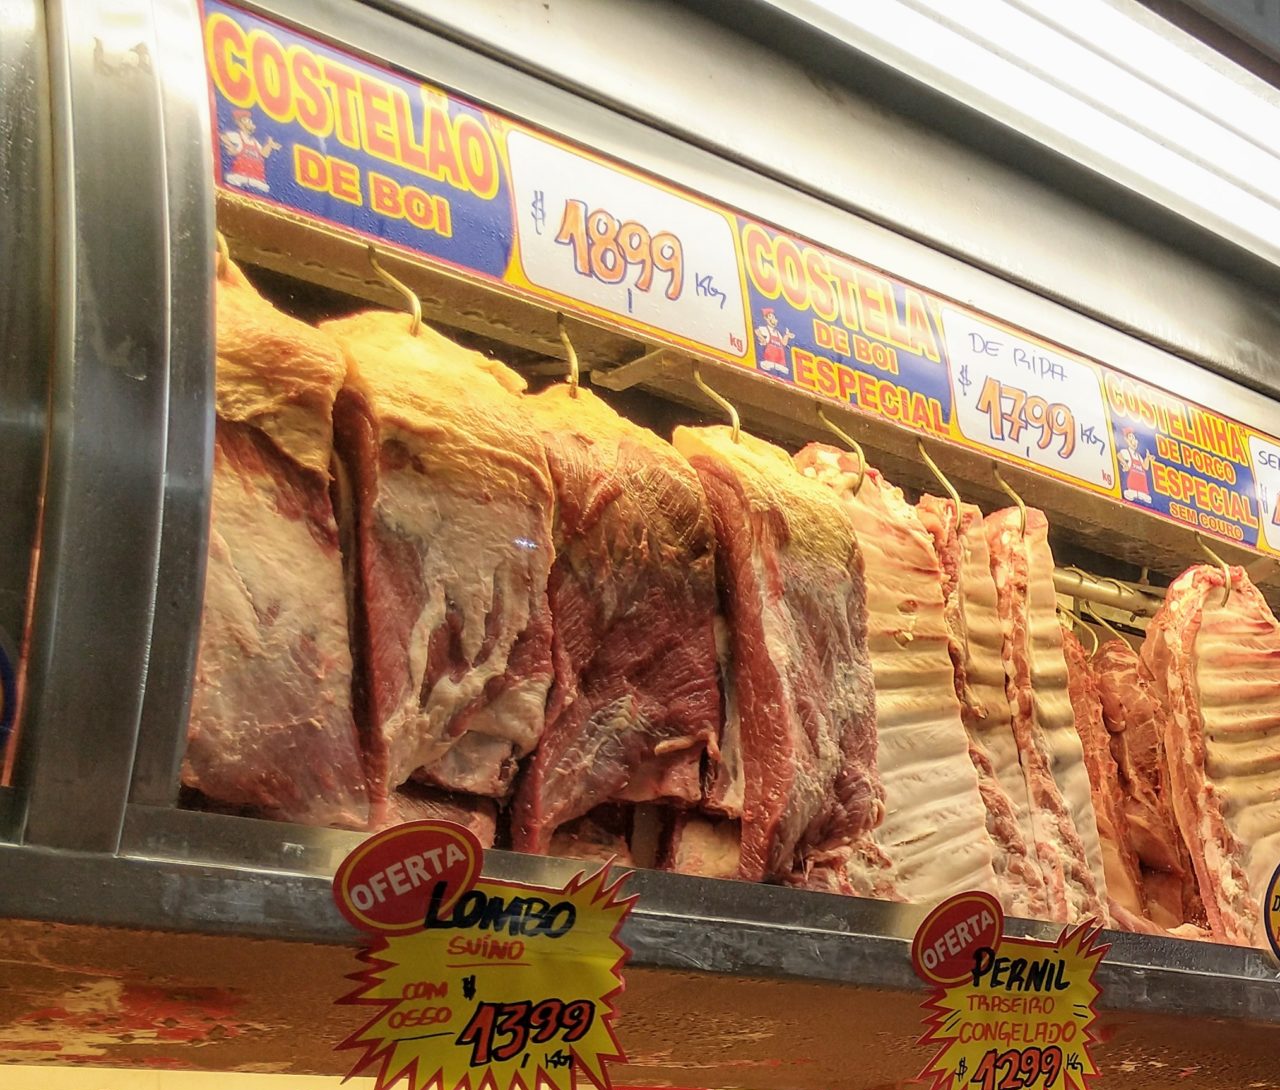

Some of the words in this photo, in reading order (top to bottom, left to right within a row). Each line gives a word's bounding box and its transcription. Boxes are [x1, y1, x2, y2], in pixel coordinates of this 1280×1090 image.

[205, 11, 502, 202] COSTELÃO
[294, 144, 363, 206] DE
[369, 170, 453, 238] BOI
[743, 224, 943, 362] COSTELA
[813, 319, 850, 357] DE
[853, 332, 899, 375] BOI
[968, 332, 1004, 357] DE
[791, 347, 951, 436] ESPECIAL
[1104, 372, 1249, 466] COSTELINHA
[1154, 432, 1182, 465] DE
[1183, 444, 1236, 486] PORCO
[1151, 459, 1260, 529] ESPECIAL
[1168, 500, 1198, 525] SEM
[1199, 509, 1244, 542] COURO
[350, 844, 467, 911] OFERTA
[425, 881, 577, 939] LOMBO
[922, 910, 995, 970] OFERTA
[402, 982, 448, 1001] COM
[972, 946, 1071, 993] PERNIL
[958, 1019, 1077, 1046] CONGELADO
[966, 994, 1055, 1015] TRASEIRO
